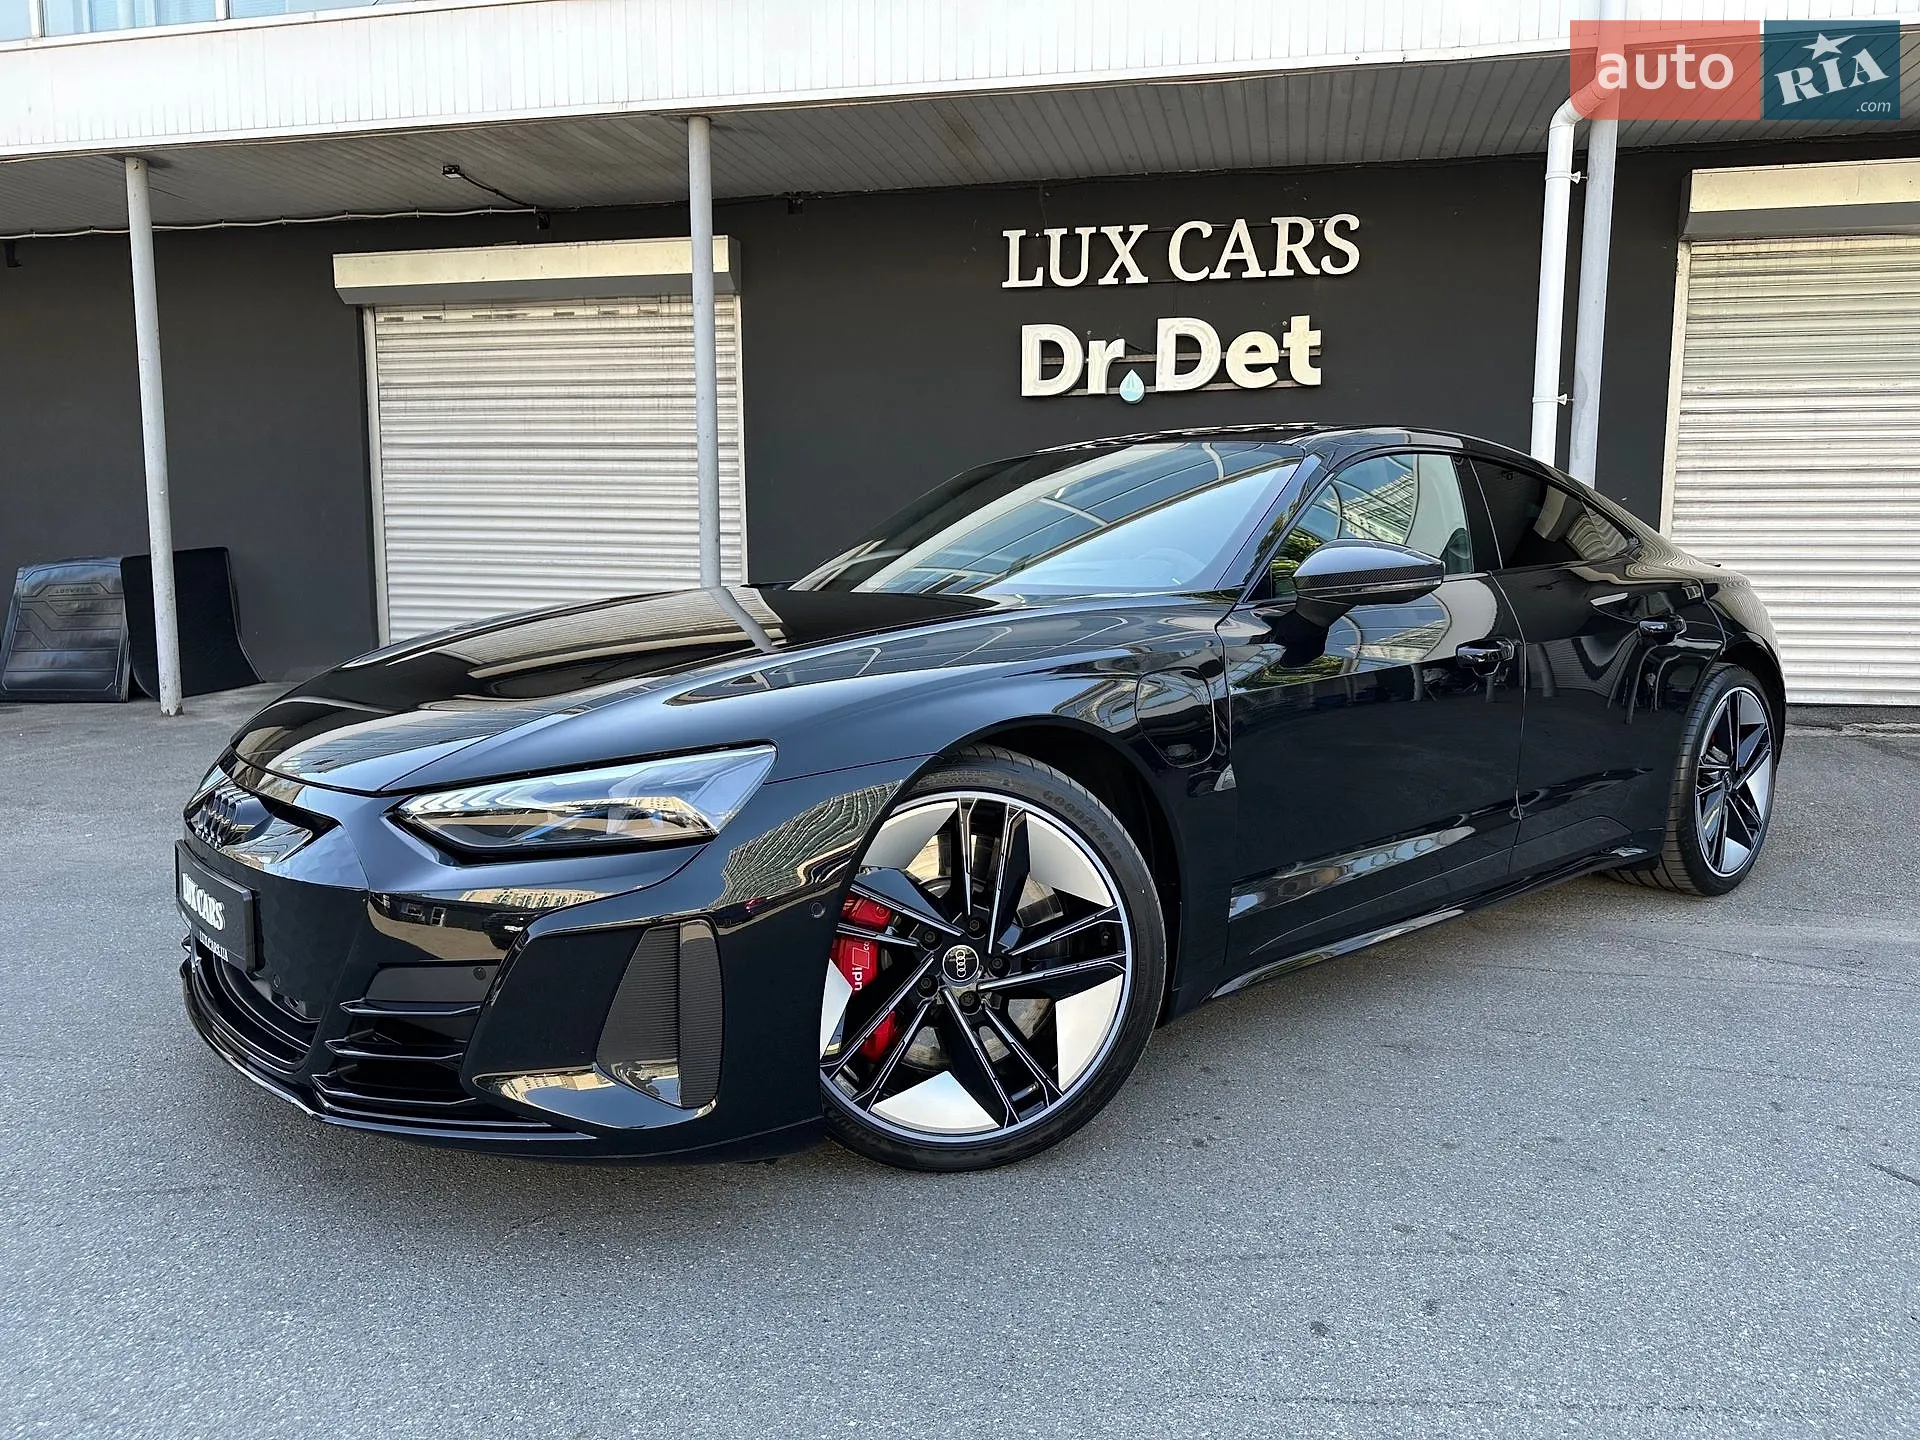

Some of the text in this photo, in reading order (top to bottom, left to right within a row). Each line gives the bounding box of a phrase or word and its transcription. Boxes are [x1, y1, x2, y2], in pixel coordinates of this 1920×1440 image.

[1002, 213, 1361, 289] LUX CARS
[197, 889, 225, 931] CARS
[852, 966, 863, 991] udi
